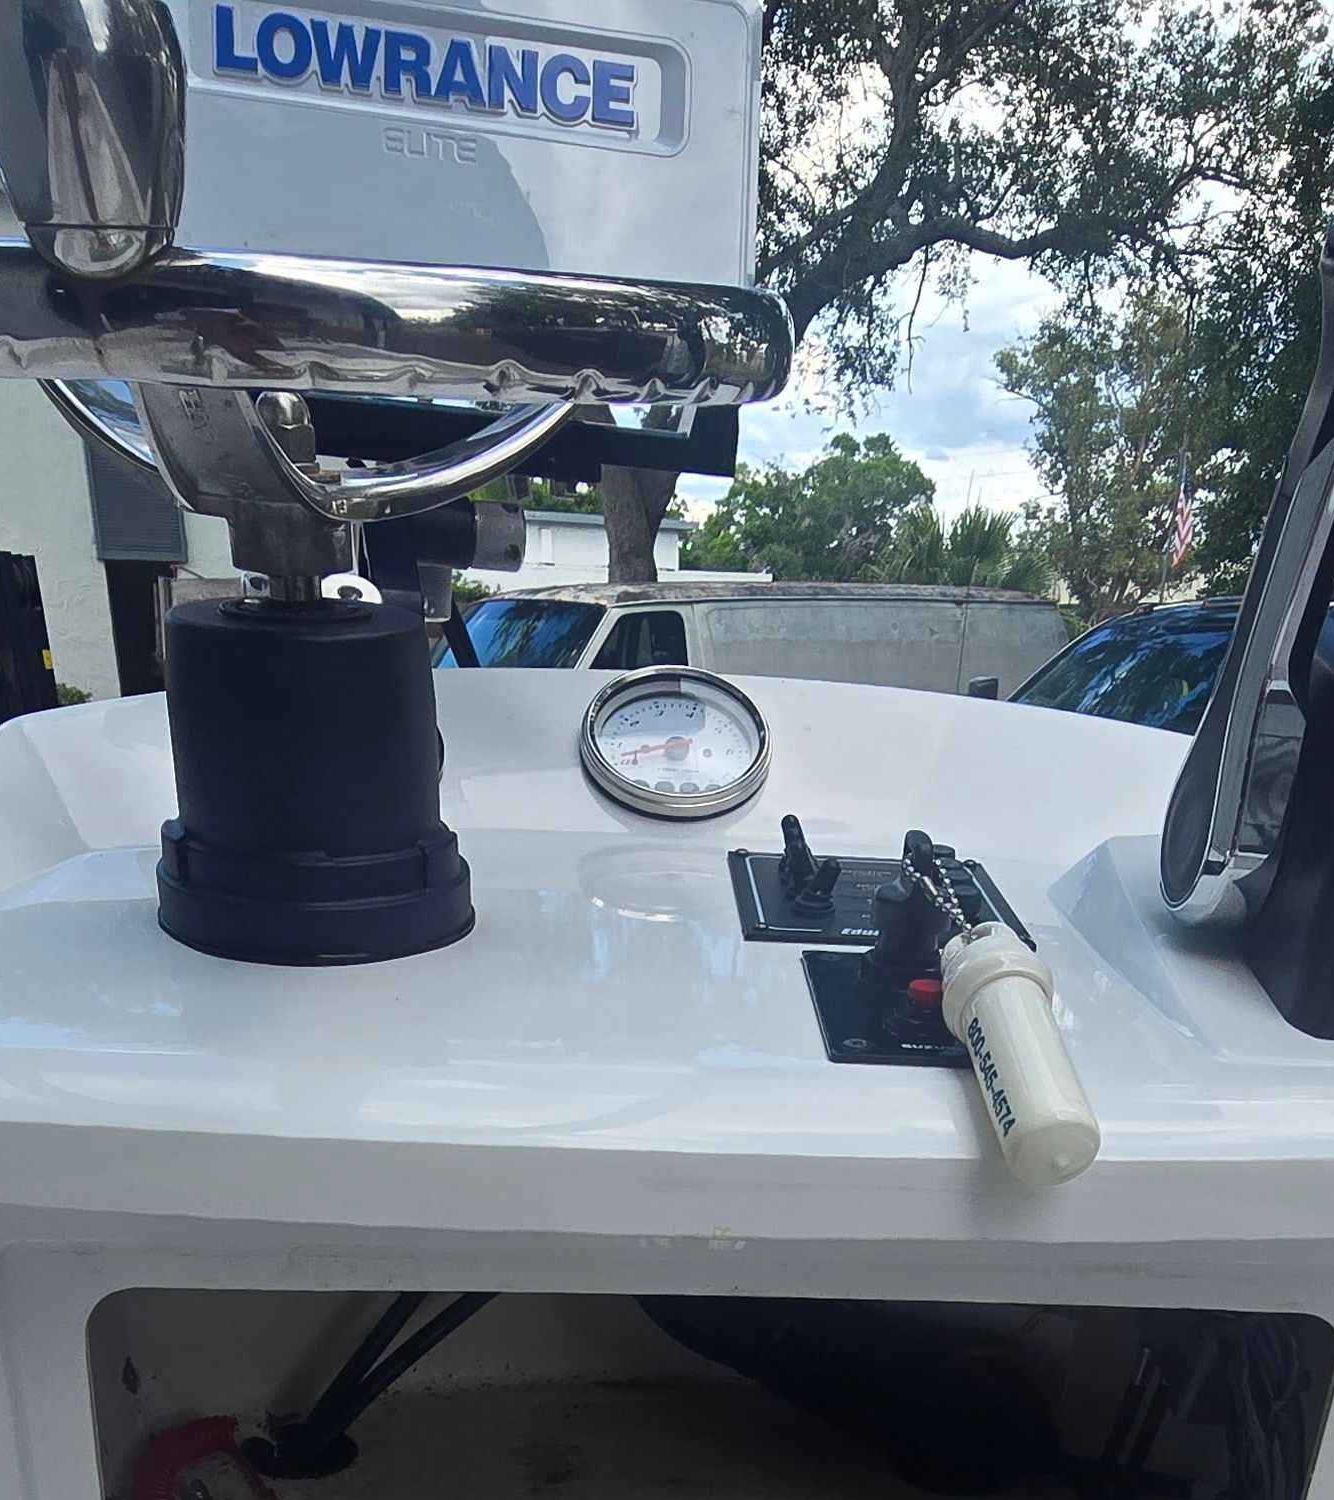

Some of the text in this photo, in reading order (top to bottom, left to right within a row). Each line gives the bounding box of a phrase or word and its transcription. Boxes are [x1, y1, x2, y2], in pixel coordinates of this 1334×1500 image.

[215, 4, 636, 128] LOWRANCE
[382, 126, 477, 165] ELITE
[967, 1017, 1016, 1138] 800-545-4574
